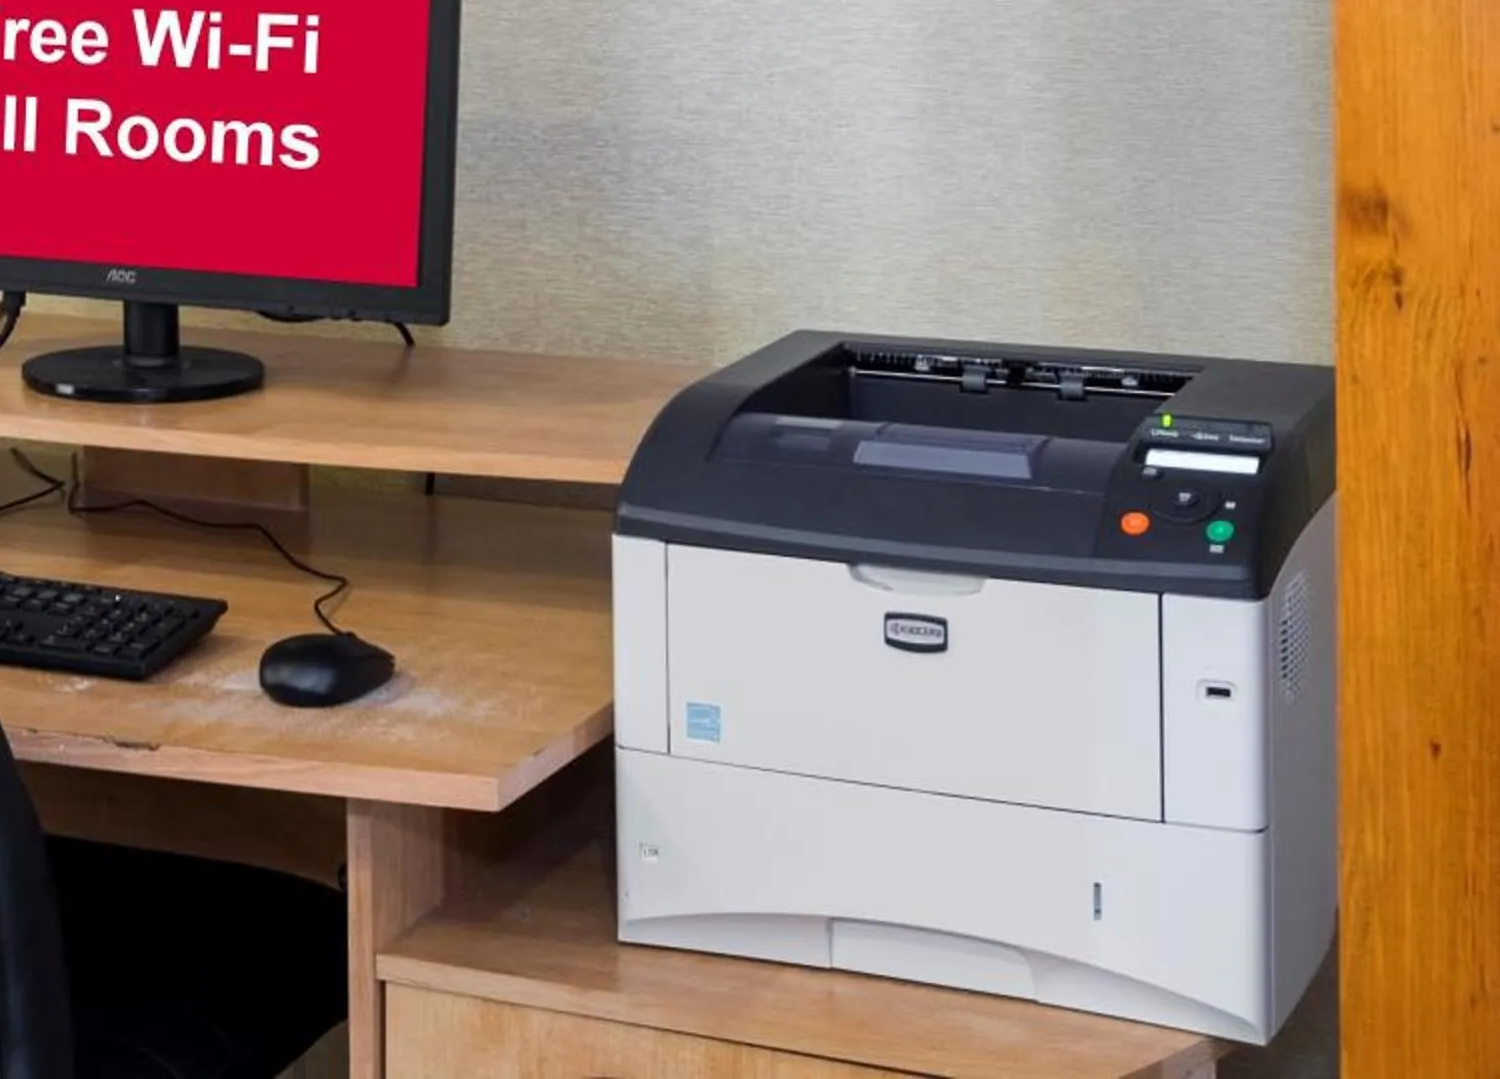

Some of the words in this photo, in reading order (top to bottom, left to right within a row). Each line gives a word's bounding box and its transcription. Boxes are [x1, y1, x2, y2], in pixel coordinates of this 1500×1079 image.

[132, 8, 319, 74] Wi-Fi
[65, 98, 320, 170] Rooms
[106, 268, 137, 284] AOC
